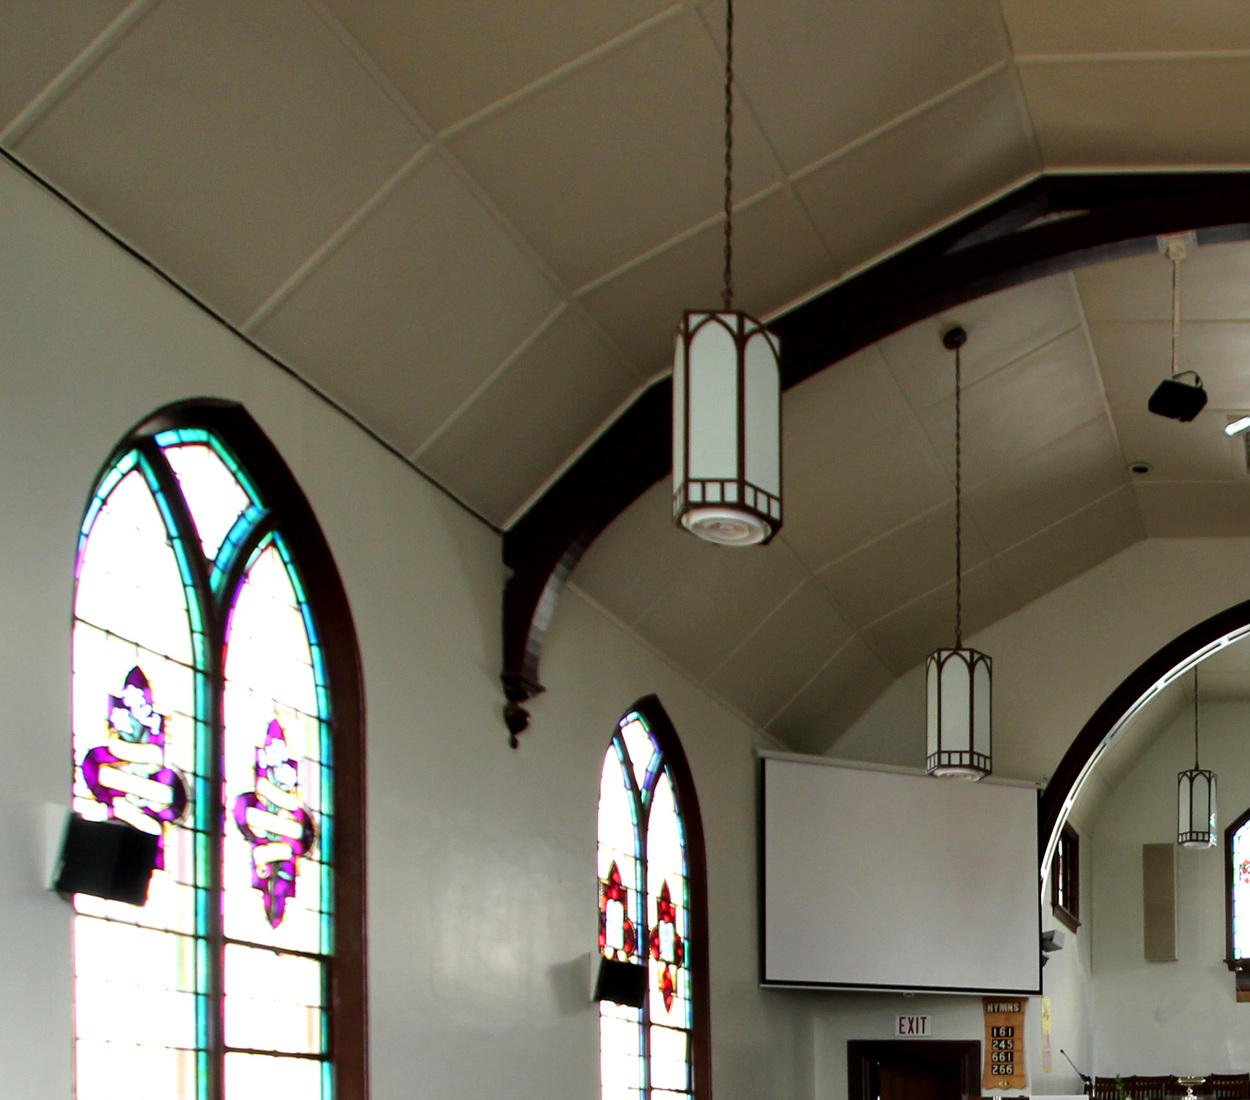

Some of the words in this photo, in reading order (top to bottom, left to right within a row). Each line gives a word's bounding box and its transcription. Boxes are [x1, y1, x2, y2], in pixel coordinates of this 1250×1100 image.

[987, 1002, 1021, 1013] HYMNS
[899, 1016, 927, 1035] EXIT
[993, 1027, 1014, 1038] 161
[993, 1040, 1014, 1050] 245
[993, 1052, 1014, 1062] 661
[993, 1065, 1014, 1075] 266
